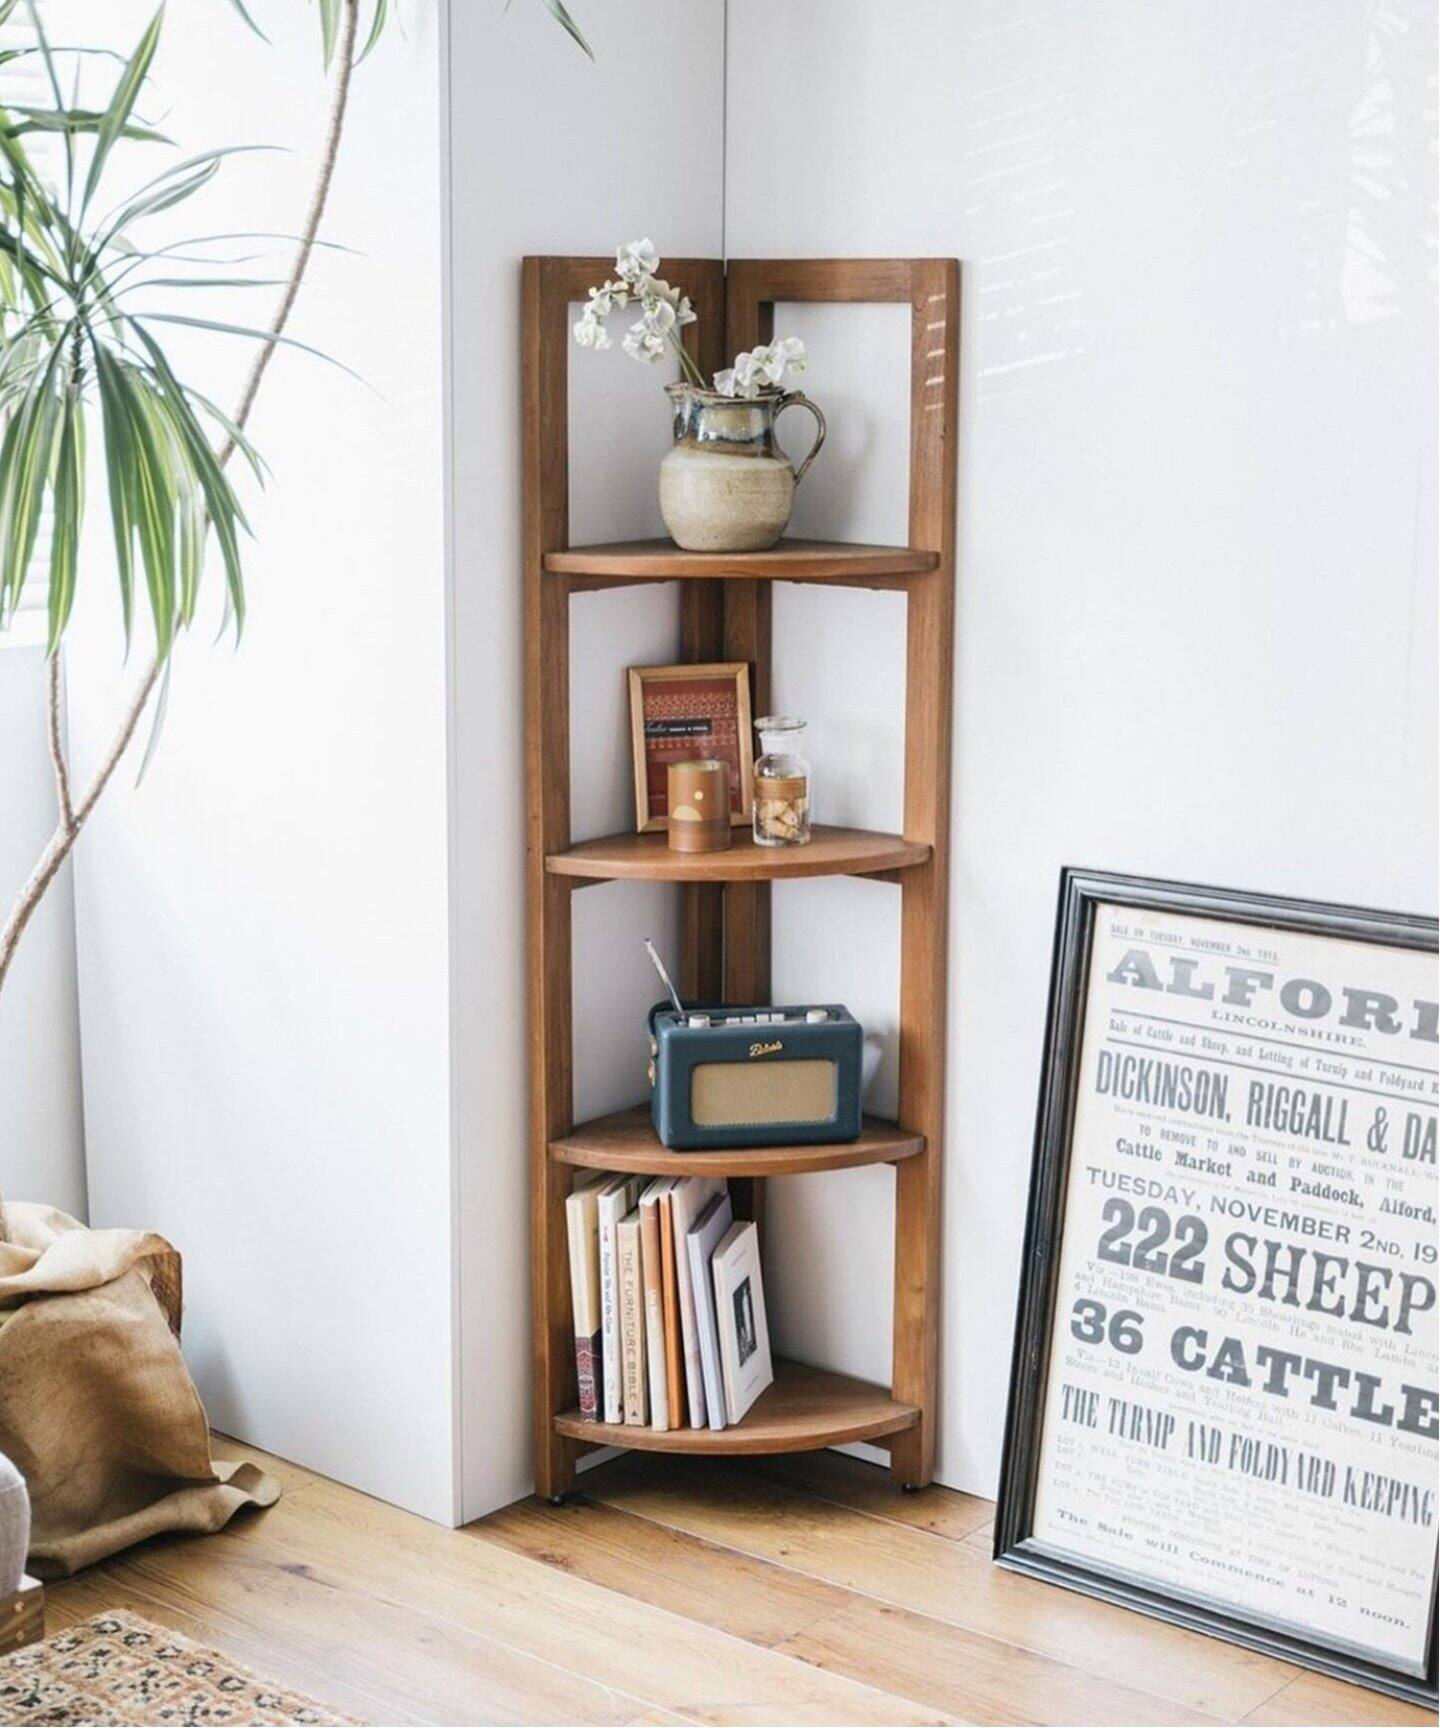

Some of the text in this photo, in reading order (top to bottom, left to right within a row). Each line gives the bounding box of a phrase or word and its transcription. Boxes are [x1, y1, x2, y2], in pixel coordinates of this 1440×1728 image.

[1108, 1019, 1127, 1032] Sale
[1133, 1023, 1142, 1036] of
[1146, 1026, 1173, 1041] Cattle
[1179, 1033, 1195, 1045] and
[1200, 1036, 1229, 1054] Sheep,
[1234, 1043, 1252, 1056] and
[1258, 1048, 1294, 1068] Letting
[1299, 1056, 1309, 1068] of
[1315, 1059, 1348, 1079] Turnip
[1354, 1067, 1372, 1081] and
[1378, 1070, 1425, 1093] Foldyard
[1211, 1010, 1367, 1047] LINCOLNSHIRE.
[1095, 1050, 1234, 1121] DICKINSON,
[1247, 1081, 1353, 1144] RIGGALL
[1367, 1105, 1389, 1153] &
[1116, 1137, 1163, 1161] Cattle
[1174, 1150, 1232, 1177] Market
[1246, 1166, 1277, 1187] and
[1289, 1175, 1365, 1208] Paddock,
[1379, 1196, 1437, 1223] Alford,
[1139, 1124, 1151, 1136] TO
[1159, 1128, 1196, 1146] REMOVE
[1206, 1138, 1219, 1152] TO
[1227, 1143, 1246, 1157] AND
[1255, 1149, 1278, 1165] SELL
[1288, 1156, 1301, 1169] BY
[1364, 1174, 1374, 1185] IN
[1386, 1178, 1405, 1192] THE
[1085, 1166, 1201, 1208] TUESDAY,
[1210, 1195, 1350, 1243] NOVEMBER
[1413, 1242, 1440, 1265] 19
[1097, 1195, 1209, 1283] 222
[1221, 1230, 1436, 1339] SHEEP
[623, 1250, 638, 1402] THE FURNITURE BIBLE
[1070, 1296, 1145, 1357] 36
[1169, 1321, 1440, 1438] CATTLE
[1060, 1384, 1099, 1427] THE
[1106, 1398, 1175, 1451] TURNIP
[1185, 1421, 1221, 1465] AND
[1229, 1433, 1336, 1499] FOLDYARD
[1343, 1466, 1434, 1529] KEEPING
[1056, 1508, 1411, 1630] The Sale will Commence at 12 noon.
